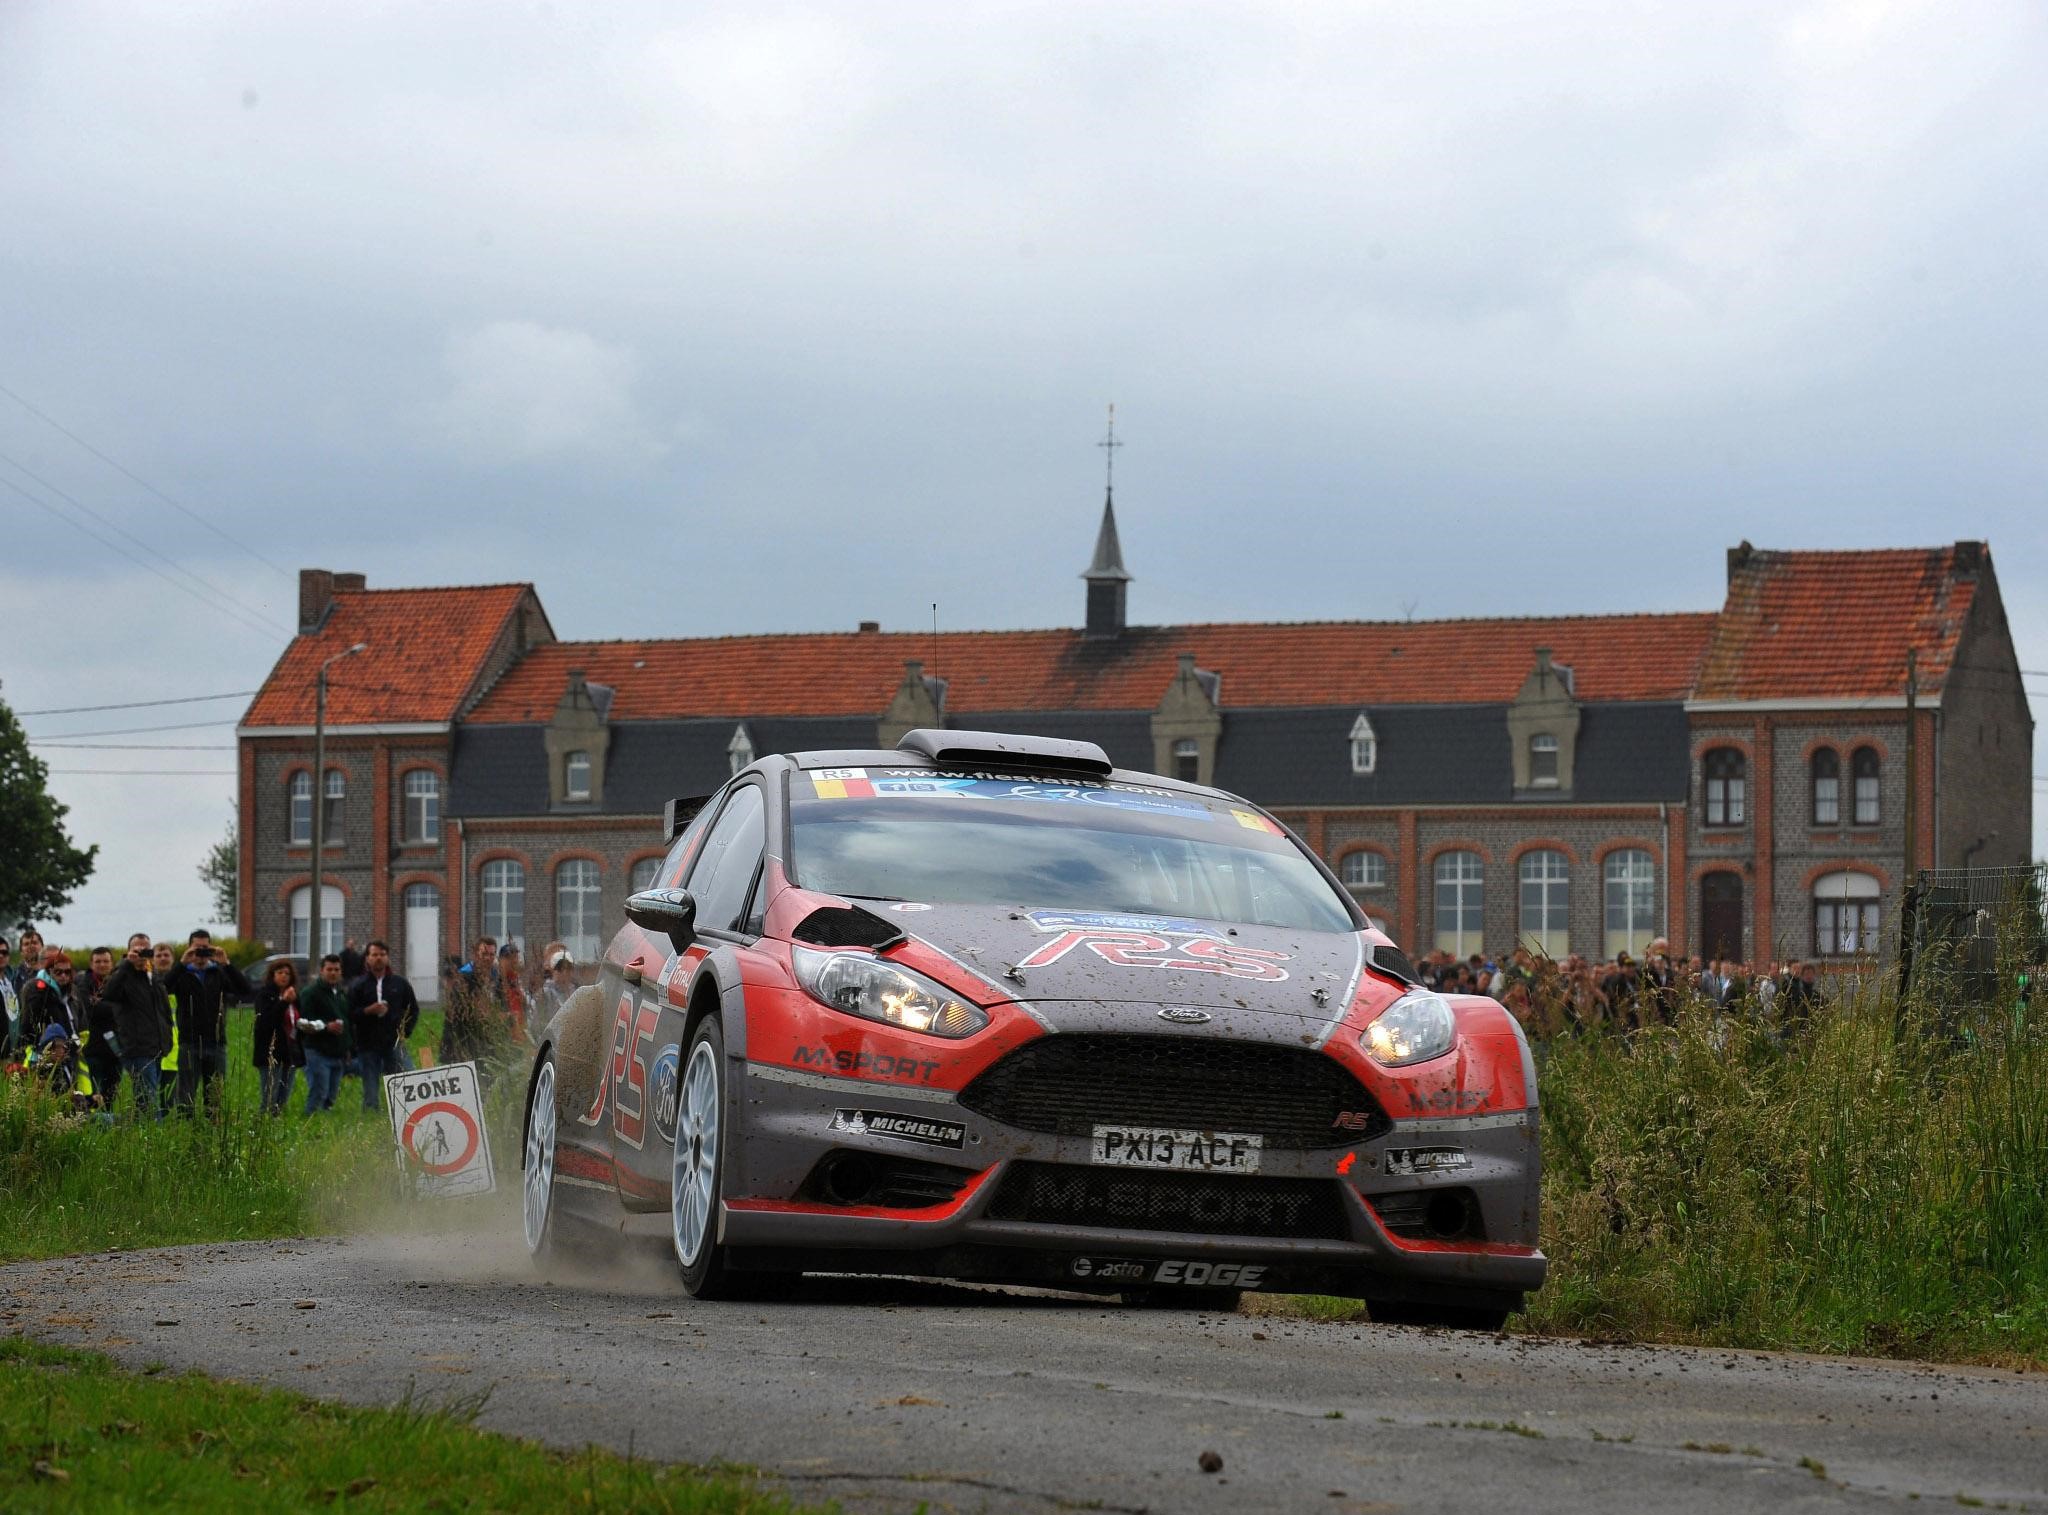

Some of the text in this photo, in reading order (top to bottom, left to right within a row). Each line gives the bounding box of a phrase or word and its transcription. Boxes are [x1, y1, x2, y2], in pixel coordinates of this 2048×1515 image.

[822, 769, 853, 779] R5
[1016, 929, 1297, 982] RS
[1169, 1008, 1200, 1019] Ford
[577, 989, 662, 1151] RS
[402, 1076, 462, 1103] ZONE
[870, 1116, 963, 1142] MICHELIN
[1332, 1111, 1371, 1131] RS
[1104, 1131, 1251, 1167] PX13 ACF
[1153, 1260, 1269, 1288] EDGE
